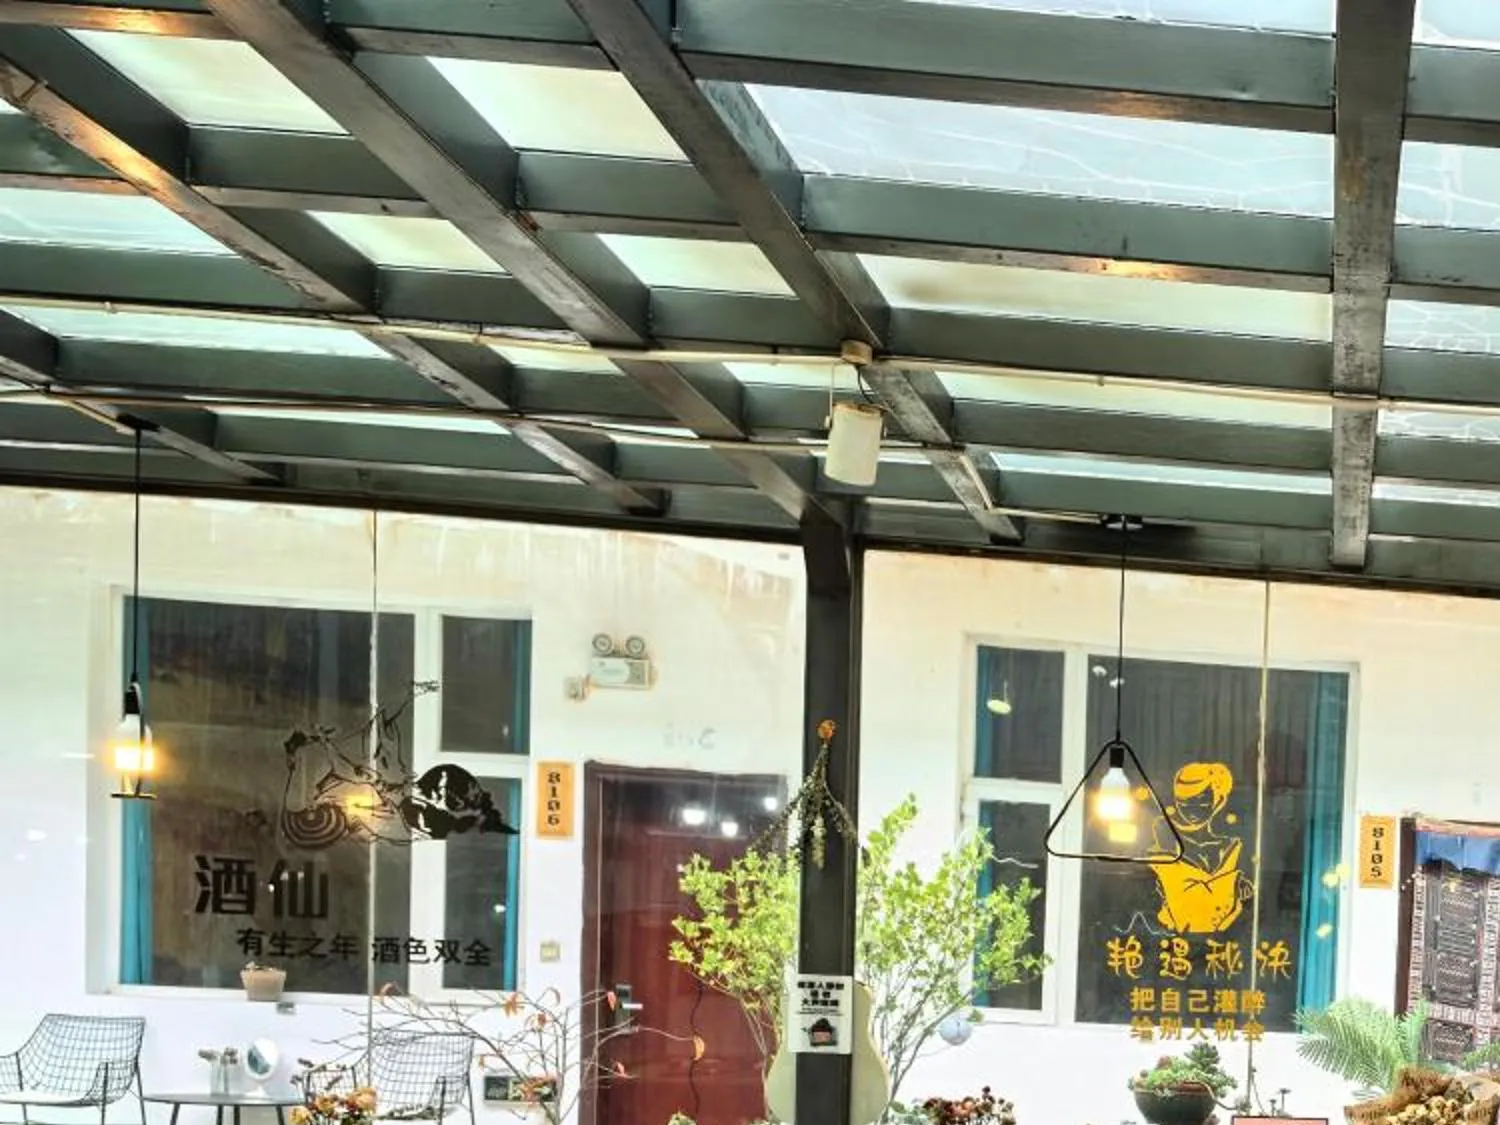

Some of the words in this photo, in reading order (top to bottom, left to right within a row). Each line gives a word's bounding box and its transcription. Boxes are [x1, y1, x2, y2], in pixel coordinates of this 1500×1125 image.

[547, 771, 561, 826] 8106
[1370, 827, 1385, 878] 8105
[195, 855, 329, 919] 酒仙
[236, 927, 360, 960] 有生之年
[371, 935, 492, 967] 酒色双全
[1129, 986, 1267, 1015] 把自己灌醉
[1129, 1015, 1266, 1043] 给别人机会
